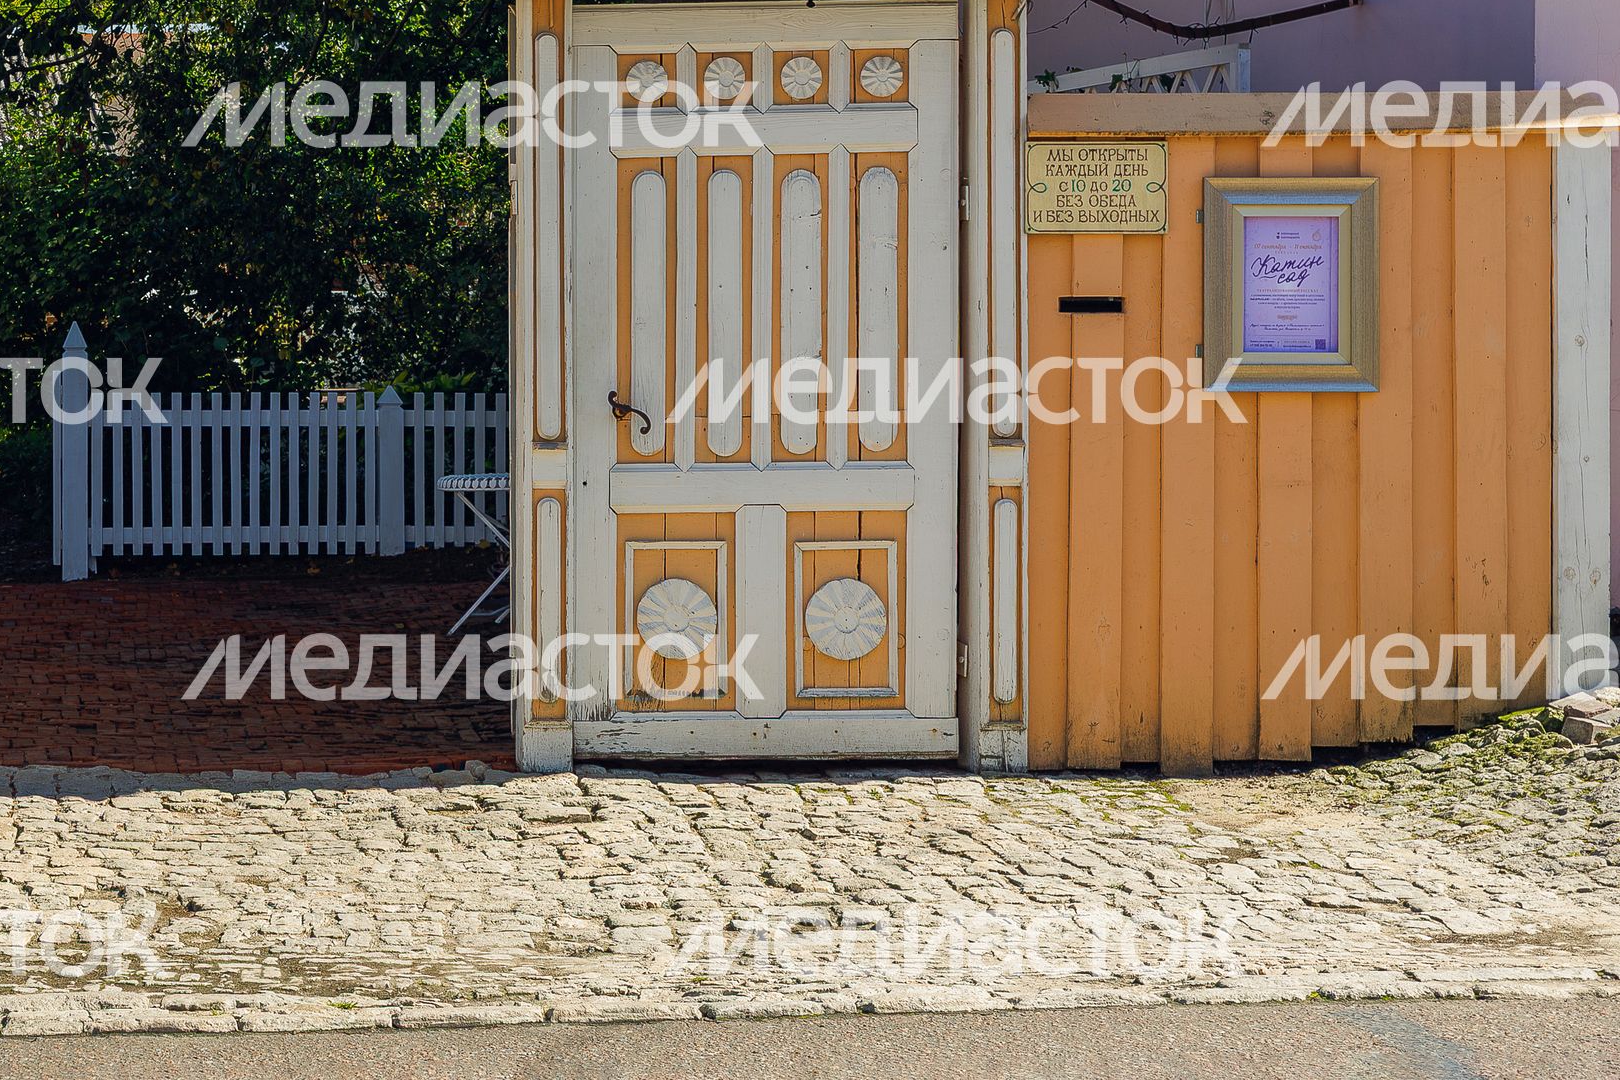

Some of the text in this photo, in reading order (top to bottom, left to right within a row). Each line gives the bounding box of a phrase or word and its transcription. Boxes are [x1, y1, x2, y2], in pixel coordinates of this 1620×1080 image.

[1046, 148, 1148, 162] МЫ ОТКРЫТЫ
[1045, 162, 1149, 178] КАЖДЫЙ ДЕНЬ
[1071, 179, 1086, 193] 10
[1111, 178, 1132, 193] 20
[1056, 194, 1137, 210] БЕЗ ОБЕДА
[1032, 210, 1160, 225] И БЕЗ ВЫХОДНЫХ
[1250, 254, 1325, 278] Катин
[1276, 268, 1311, 288] сад
